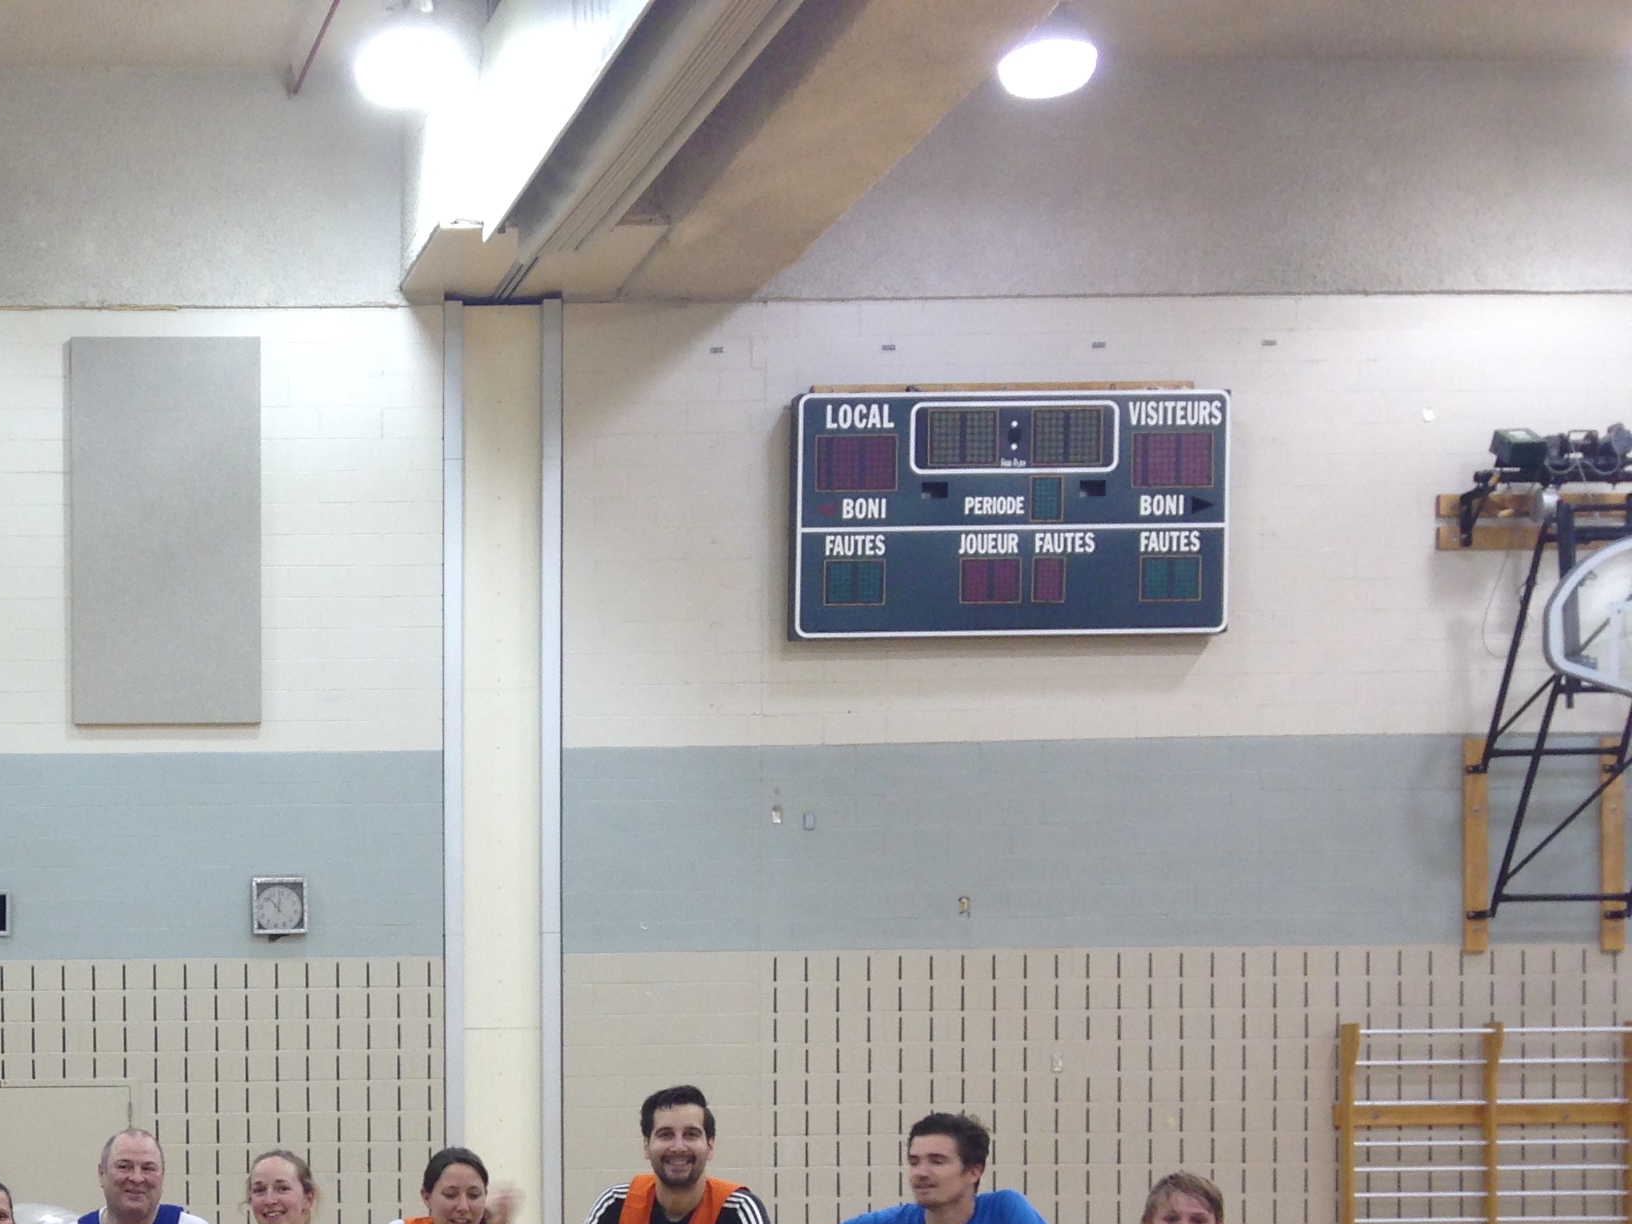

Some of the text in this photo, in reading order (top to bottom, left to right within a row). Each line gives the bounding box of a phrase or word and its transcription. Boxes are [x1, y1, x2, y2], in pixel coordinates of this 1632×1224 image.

[826, 403, 895, 429] LOCAL
[1128, 400, 1223, 426] VISITEURS
[842, 498, 887, 519] BONI
[964, 496, 1025, 516] PERIODE
[1139, 495, 1185, 516] BONI
[825, 534, 886, 556] FAUTES
[959, 533, 1019, 555] JOUEUR
[1035, 532, 1095, 554] FAUTES
[1140, 531, 1201, 552] FAUTES
